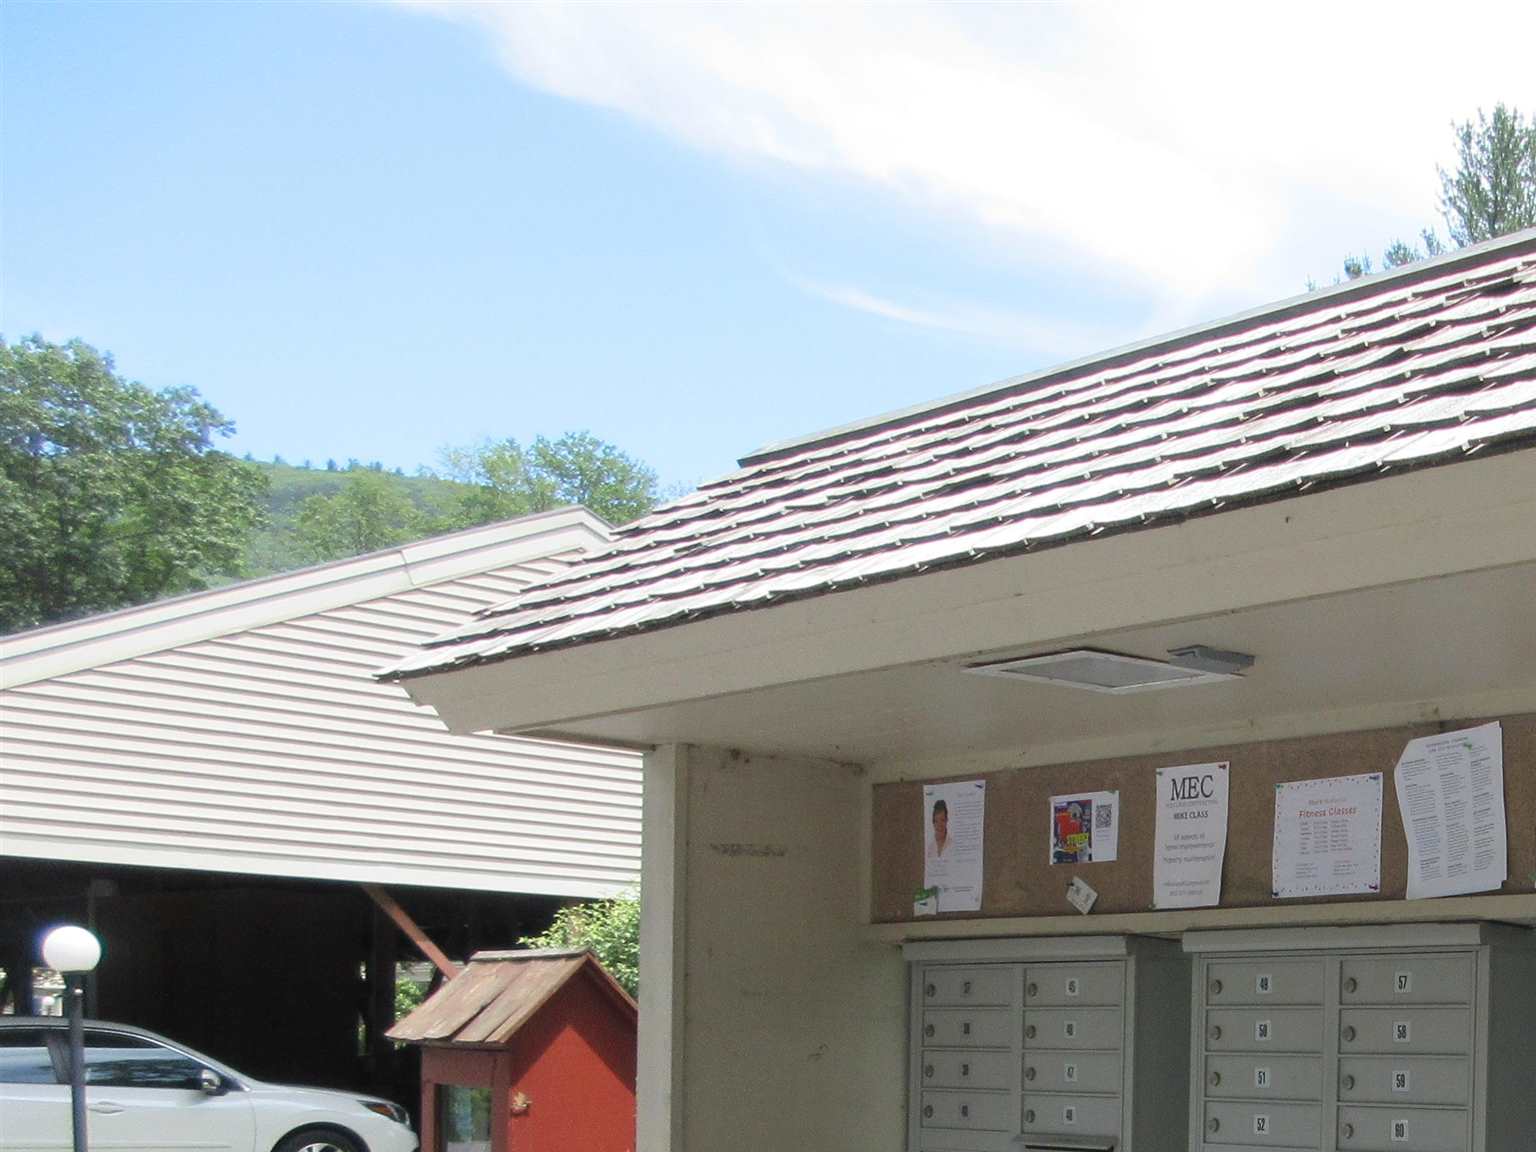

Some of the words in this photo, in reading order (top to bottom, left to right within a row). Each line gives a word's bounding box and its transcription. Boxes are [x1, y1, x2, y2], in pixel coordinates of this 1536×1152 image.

[1170, 774, 1215, 801] MEC
[1188, 809, 1209, 819] CLASS
[1328, 806, 1358, 817] Classes
[1398, 975, 1408, 990] 57
[1258, 1023, 1268, 1038] 50
[1397, 1024, 1407, 1040] 58
[1257, 1070, 1266, 1085] 51
[1396, 1073, 1406, 1088] 59
[1257, 1117, 1266, 1132] 52
[1394, 1123, 1405, 1138] 60
